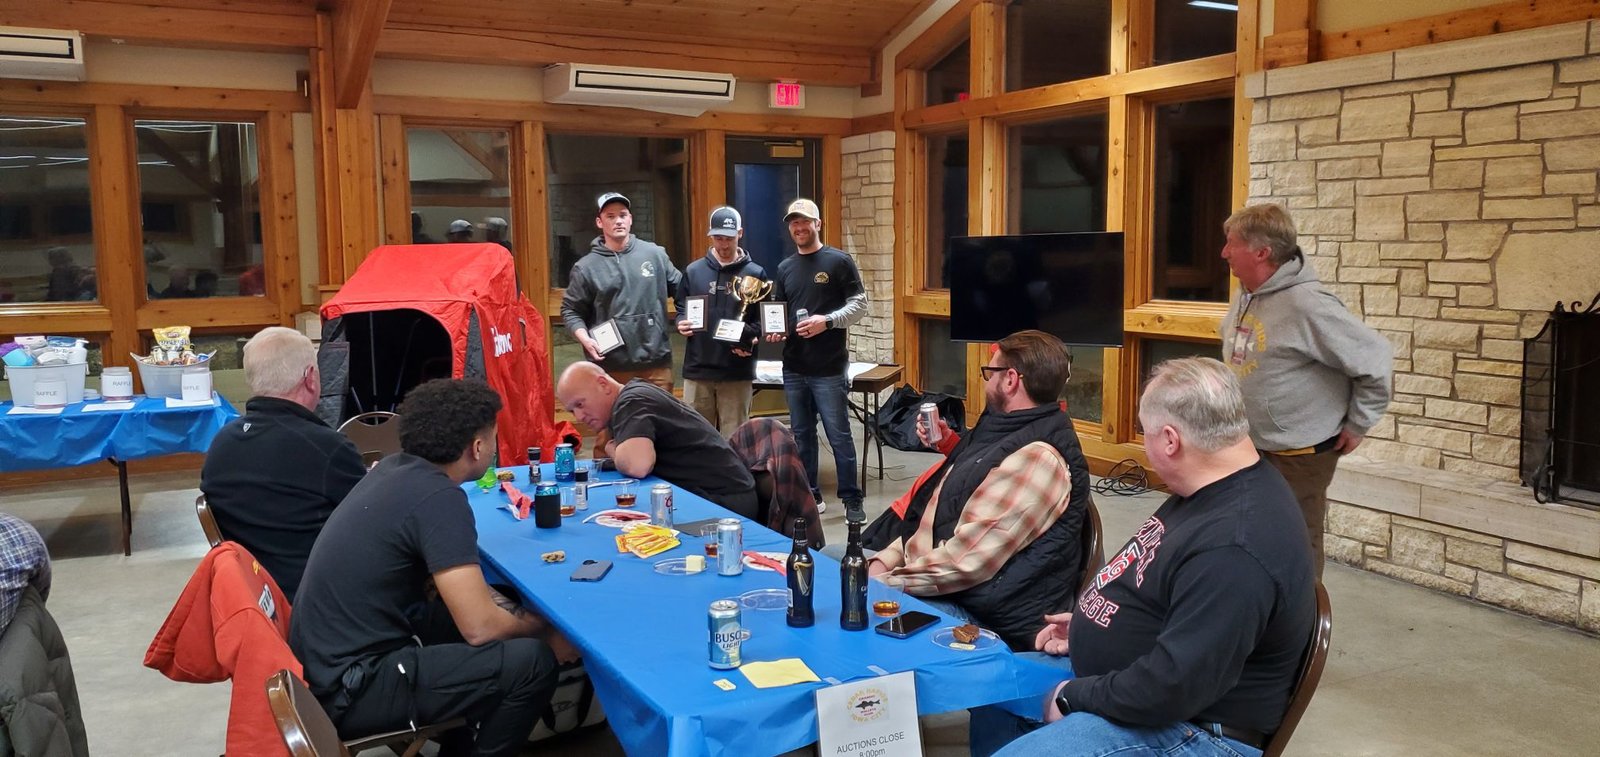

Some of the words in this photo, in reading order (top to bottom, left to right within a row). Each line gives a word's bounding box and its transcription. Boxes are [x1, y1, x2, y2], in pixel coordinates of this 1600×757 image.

[777, 84, 799, 106] EXIT
[715, 630, 741, 643] BUSC
[836, 737, 877, 754] AUCTIONS
[878, 731, 905, 745] CLOSE
